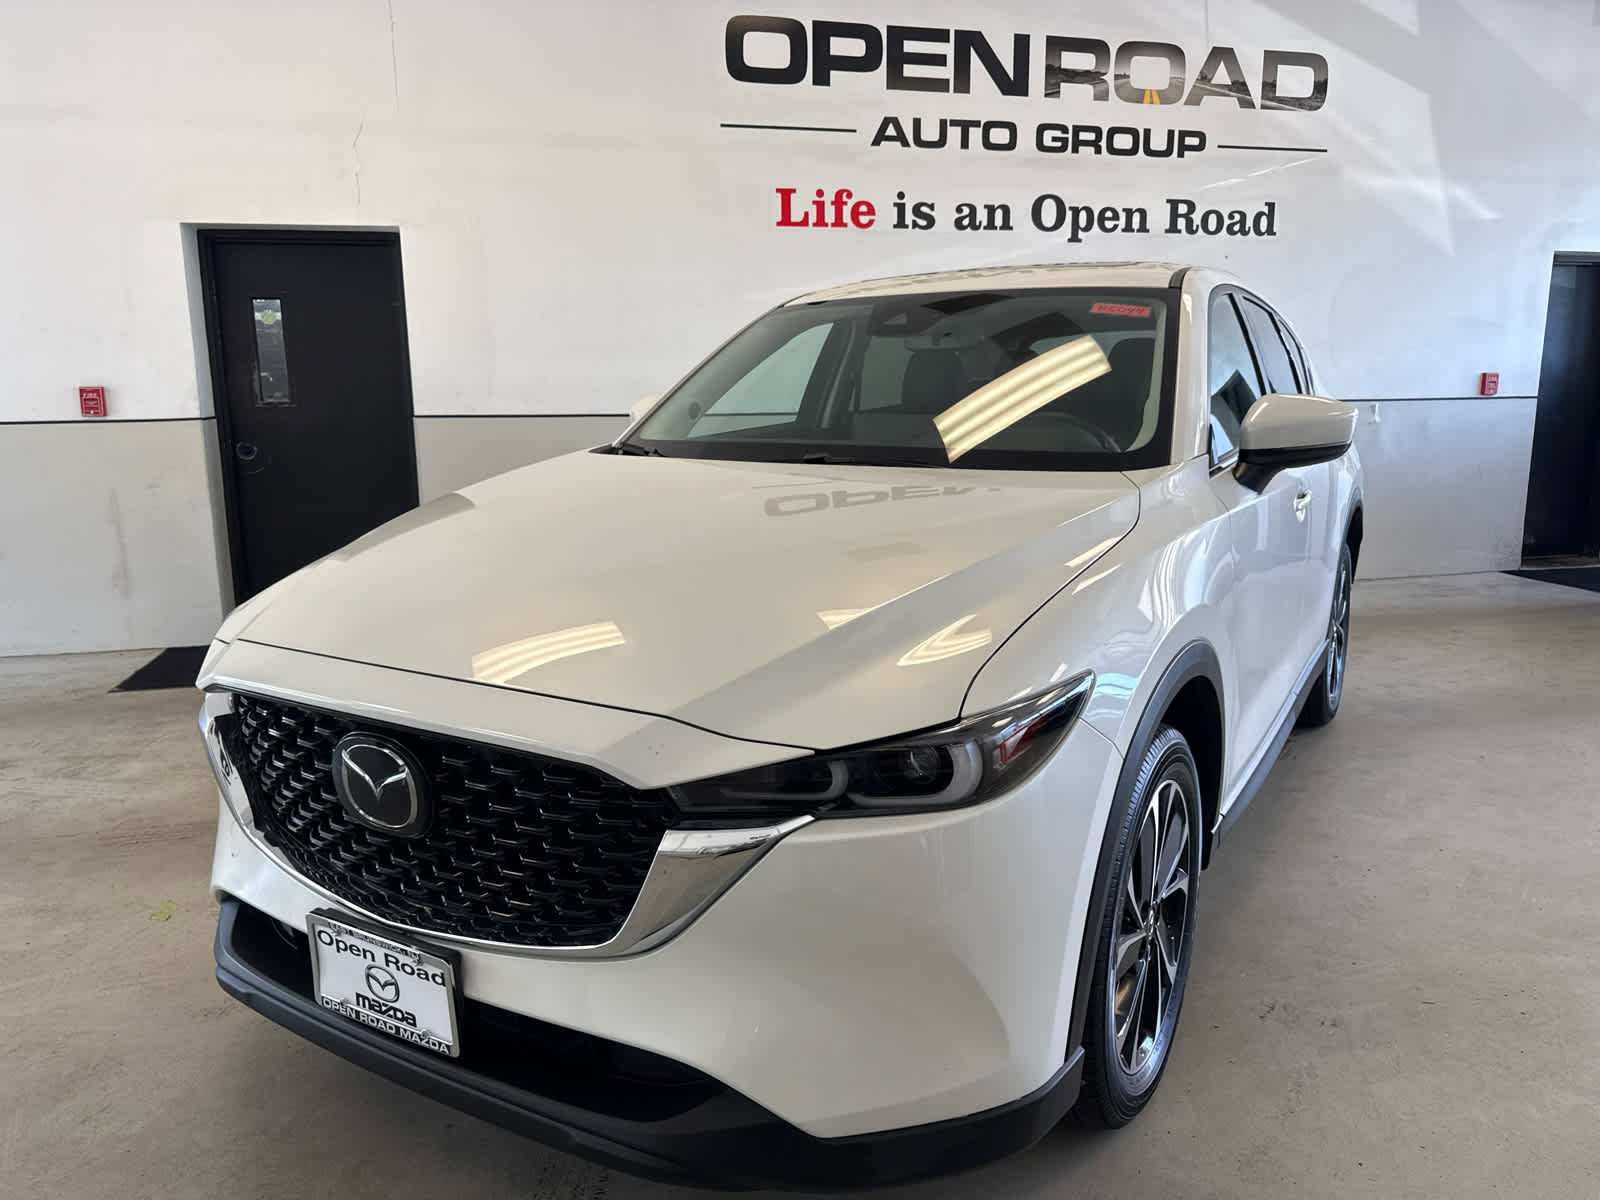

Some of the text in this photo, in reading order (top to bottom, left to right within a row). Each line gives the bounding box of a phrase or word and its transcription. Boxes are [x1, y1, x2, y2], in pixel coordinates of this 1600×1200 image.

[724, 14, 1329, 112] OPEN ROAD
[870, 116, 1207, 159] AUTO GROUP
[775, 187, 1277, 243] Life is an Open Road
[317, 929, 376, 963] Open
[384, 952, 447, 987] Road
[322, 998, 450, 1055] OPEN ROAD MAZDA
